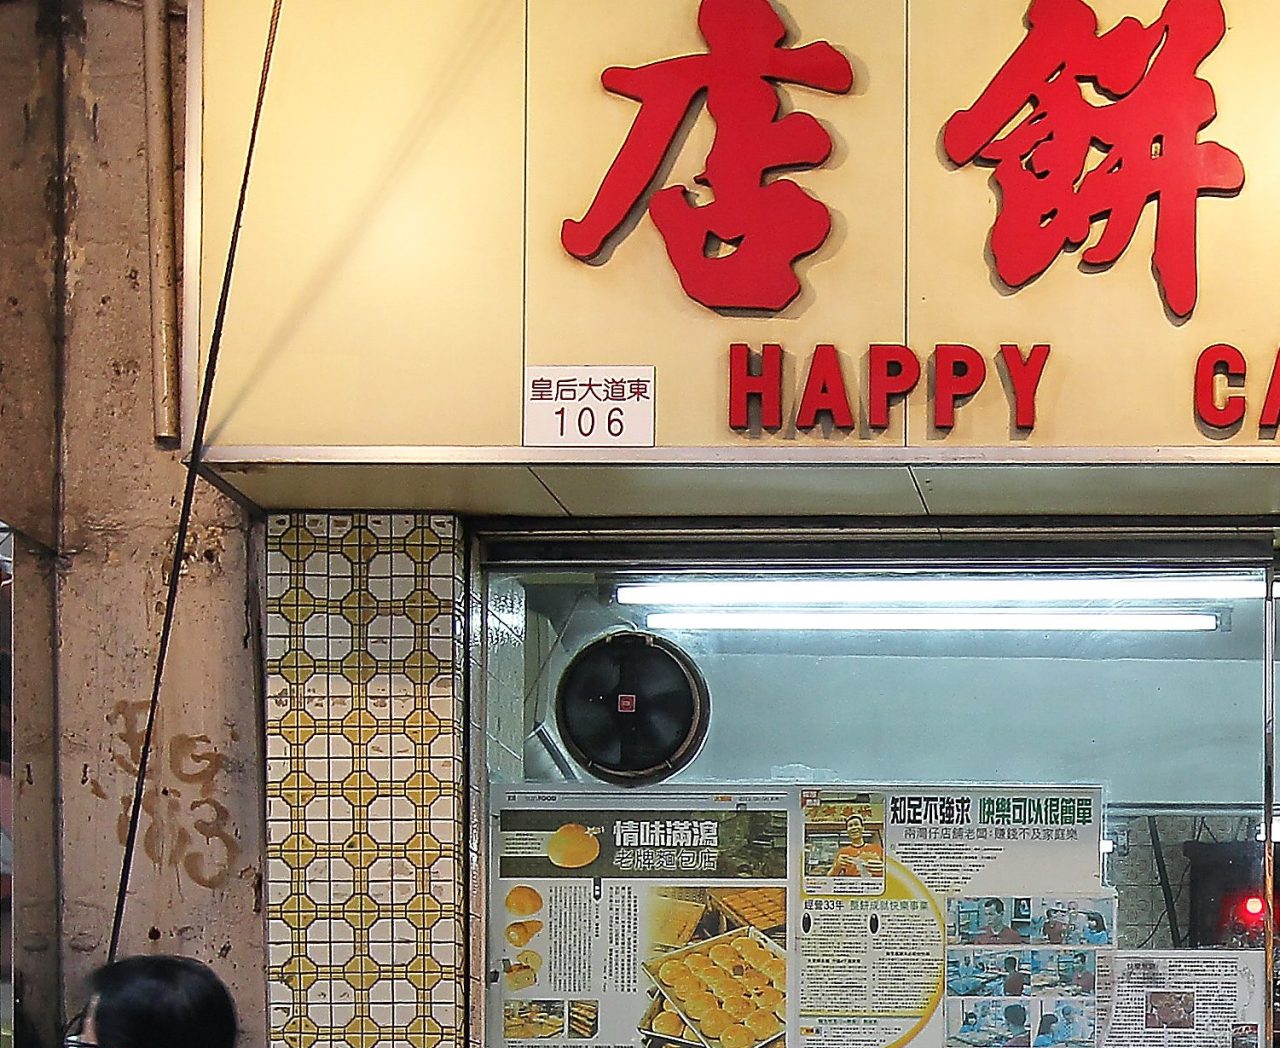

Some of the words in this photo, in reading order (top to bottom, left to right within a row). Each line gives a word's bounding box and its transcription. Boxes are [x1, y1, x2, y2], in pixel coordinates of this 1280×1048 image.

[530, 377, 651, 402] 皇后大道東
[730, 344, 1050, 429] HAPPY
[555, 407, 624, 437] 106
[890, 796, 971, 825] 知足不強求
[978, 797, 1093, 826] 快樂可以很簡單
[613, 820, 718, 847] 情味滿瀉
[613, 850, 718, 870] 老牌麵包店
